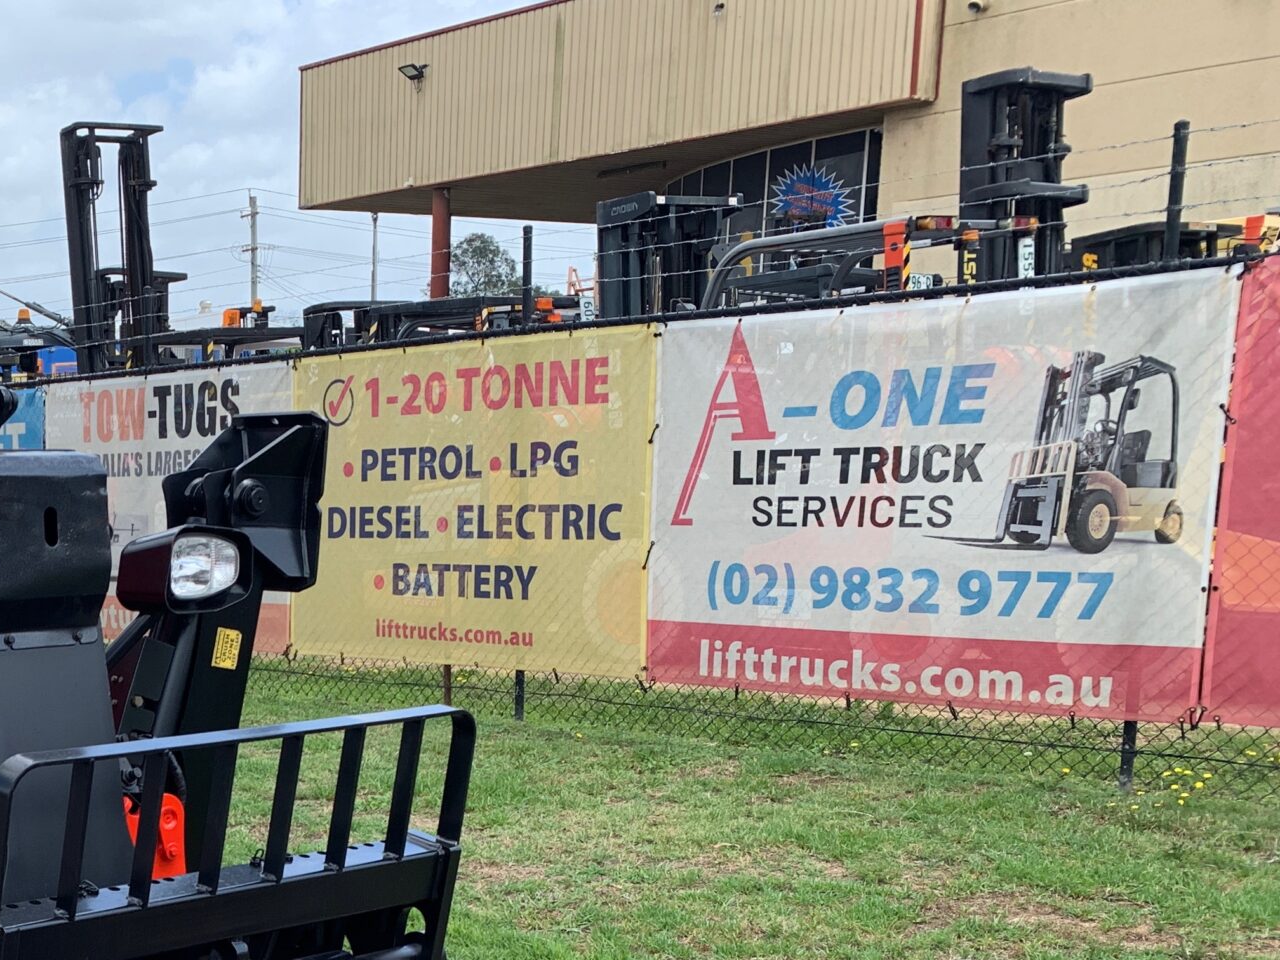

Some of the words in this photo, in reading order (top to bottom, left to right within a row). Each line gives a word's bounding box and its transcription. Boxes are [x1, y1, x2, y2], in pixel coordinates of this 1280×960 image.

[365, 371, 448, 418] 1-20
[456, 356, 610, 412] TONNE
[80, 378, 240, 443] TOW-TUGS
[102, 451, 143, 477] ALIA'S
[361, 444, 482, 481] PETROL
[509, 440, 579, 478] LPG
[732, 448, 821, 485] LIFT
[833, 443, 986, 485] TRUCK
[327, 505, 430, 540] DIESEL
[457, 503, 623, 541] ELECTRIC
[752, 495, 953, 529] SERVICES
[391, 562, 538, 601] BATTERY
[707, 560, 796, 613] (02)
[810, 566, 941, 614] 9832
[957, 569, 1115, 621] 9777
[375, 618, 534, 647] lifttrucks.com.au
[699, 639, 1114, 708] lifttrucks.com.au
